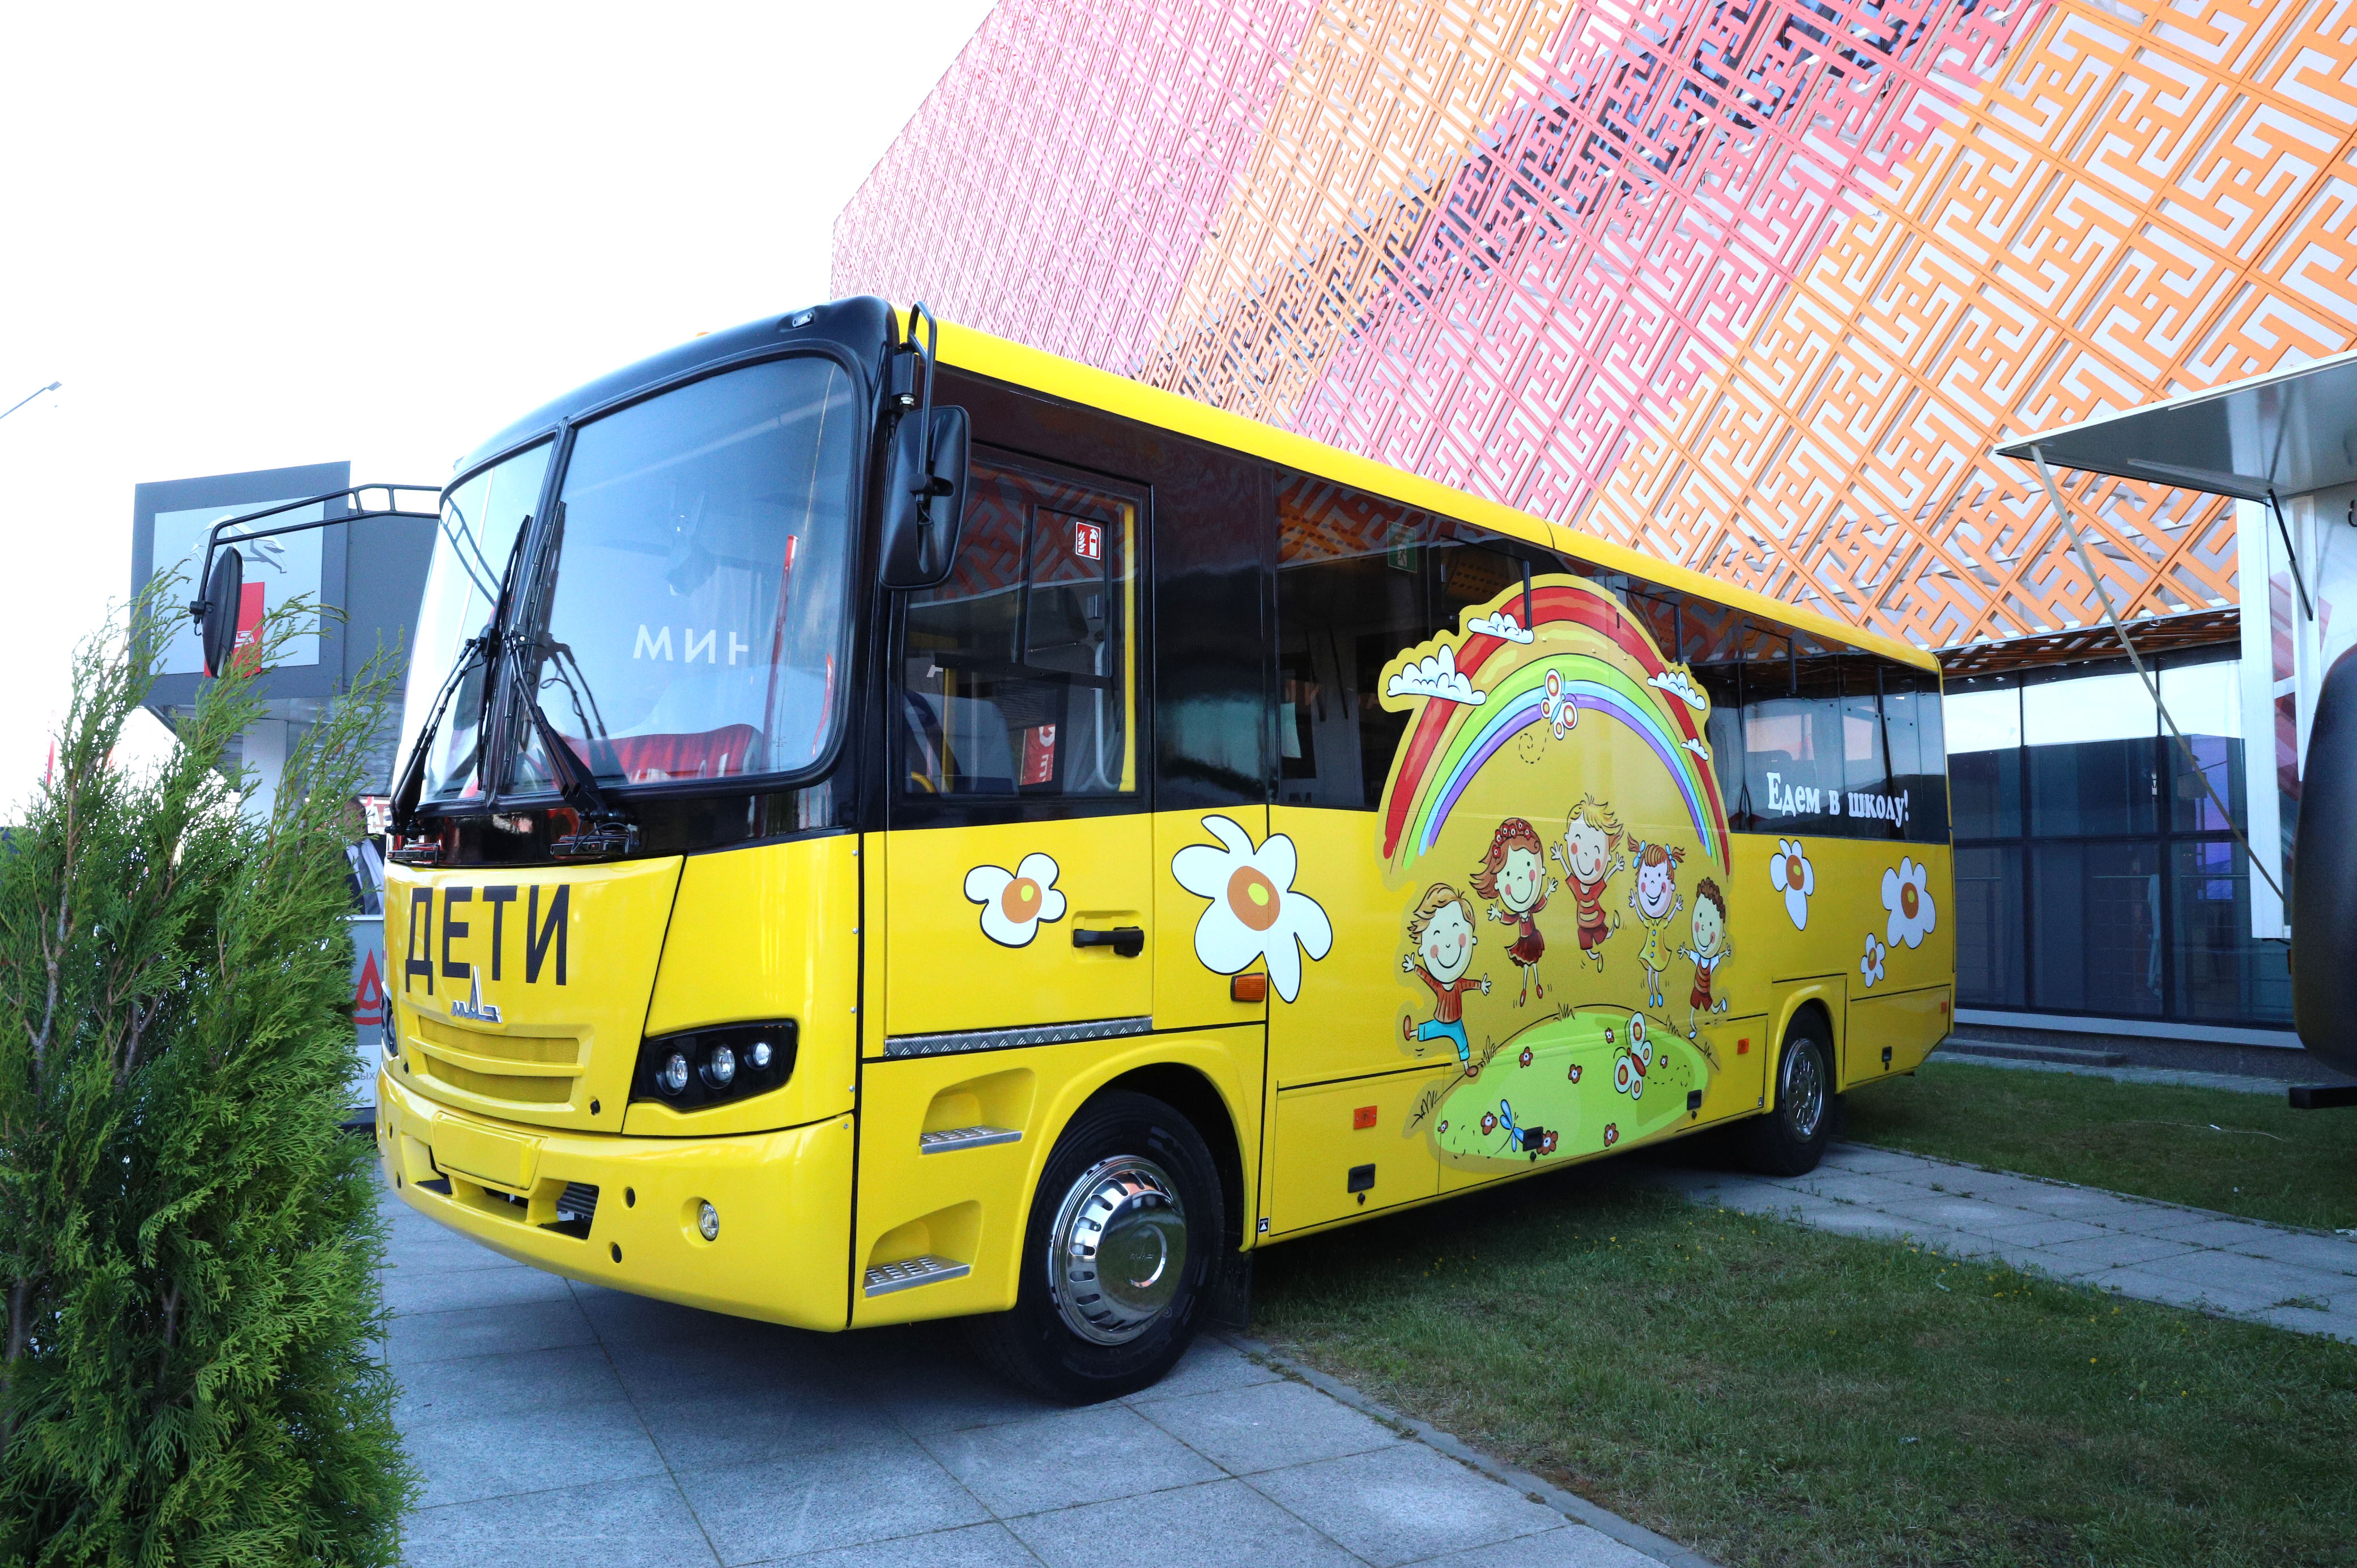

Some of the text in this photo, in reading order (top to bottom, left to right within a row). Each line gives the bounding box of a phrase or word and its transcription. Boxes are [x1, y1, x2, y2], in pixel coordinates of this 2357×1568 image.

[1766, 772, 1909, 828] Едем в школу!
[405, 884, 571, 995] ДЕТИ
